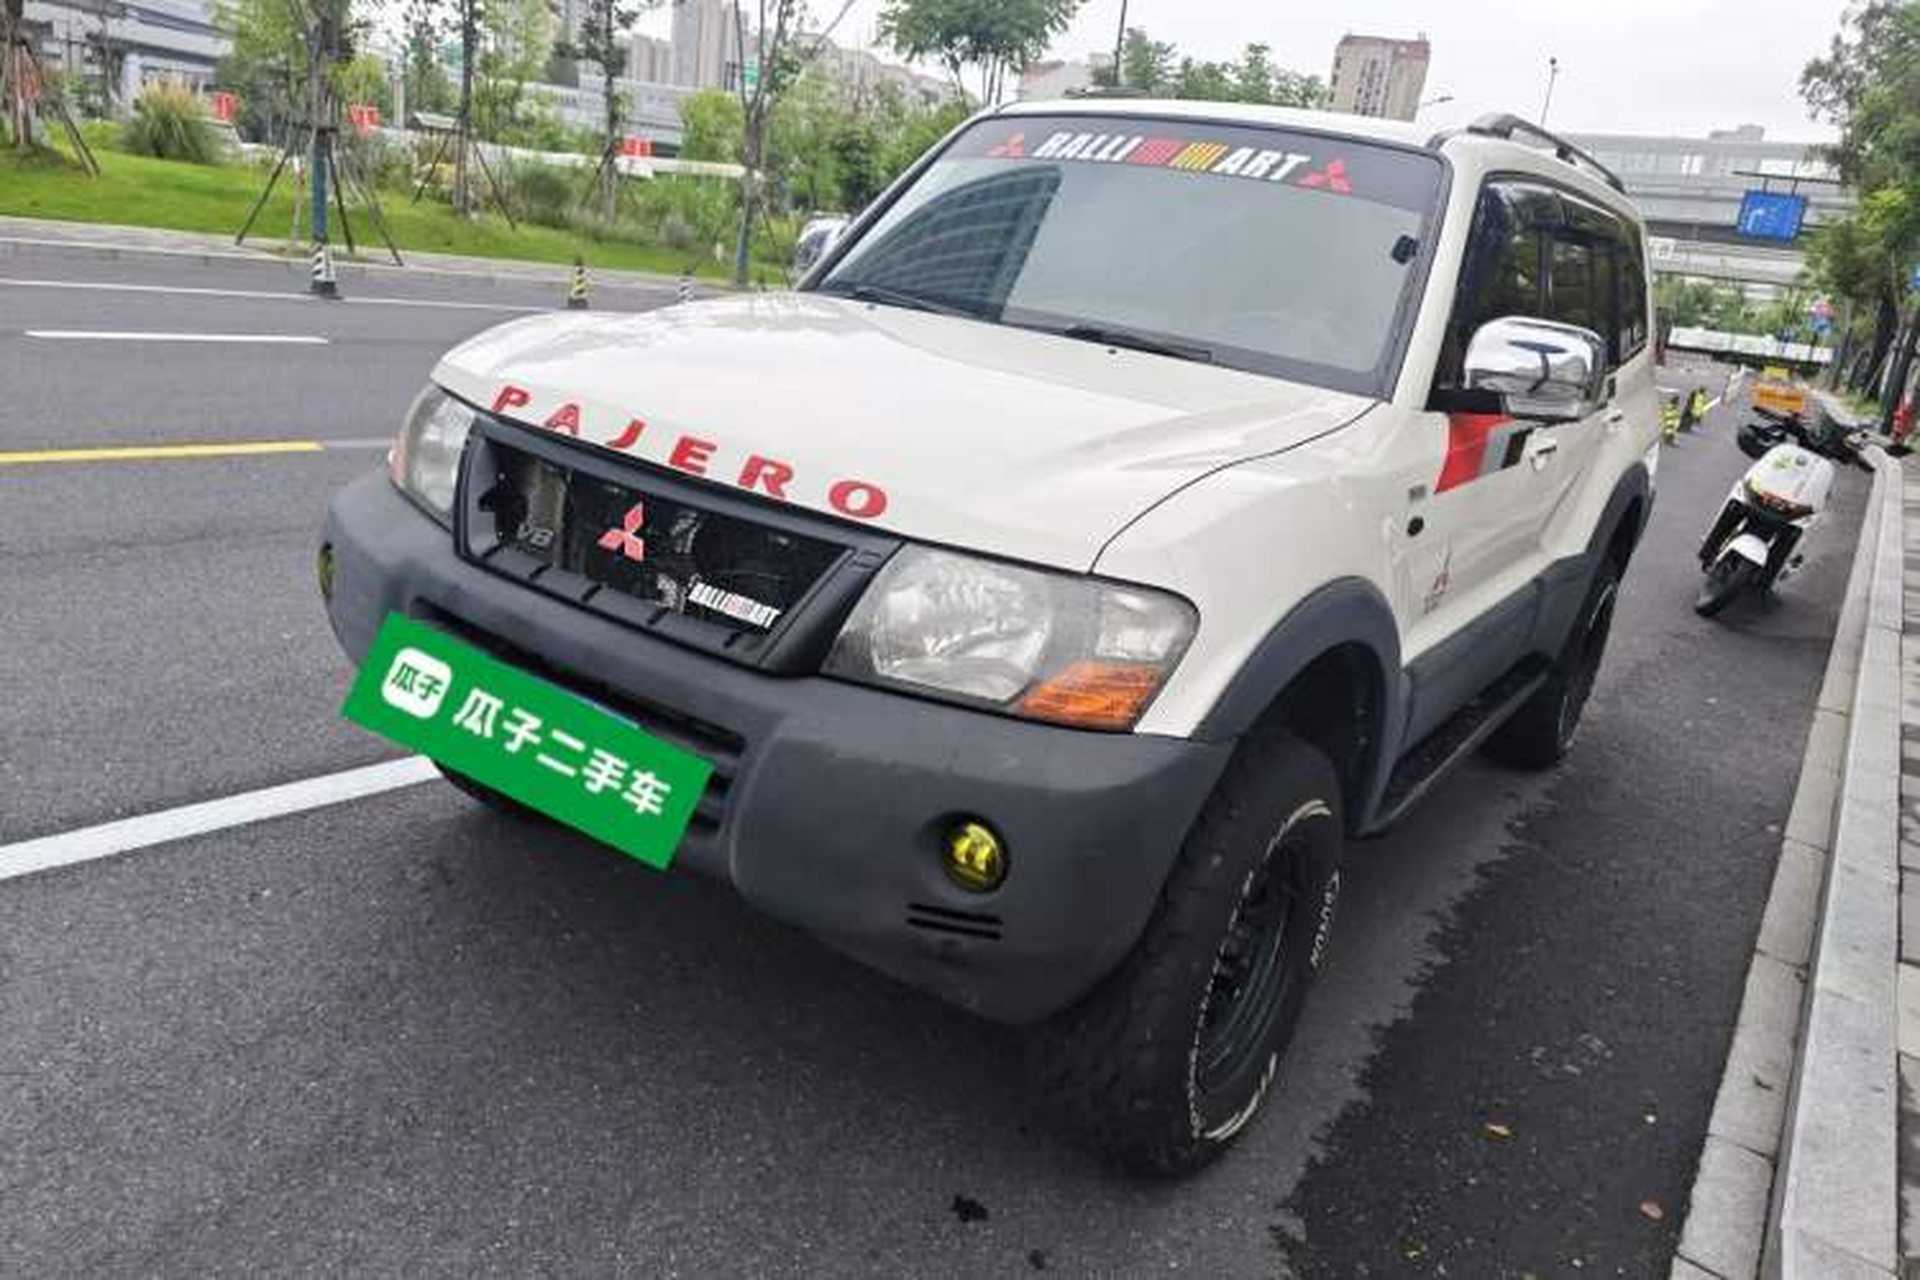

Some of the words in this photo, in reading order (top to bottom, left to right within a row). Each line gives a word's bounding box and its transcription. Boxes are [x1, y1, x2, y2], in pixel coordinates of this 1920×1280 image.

[1034, 131, 1144, 162] RALLI
[1213, 147, 1312, 181] ART
[493, 385, 888, 518] PAJERO
